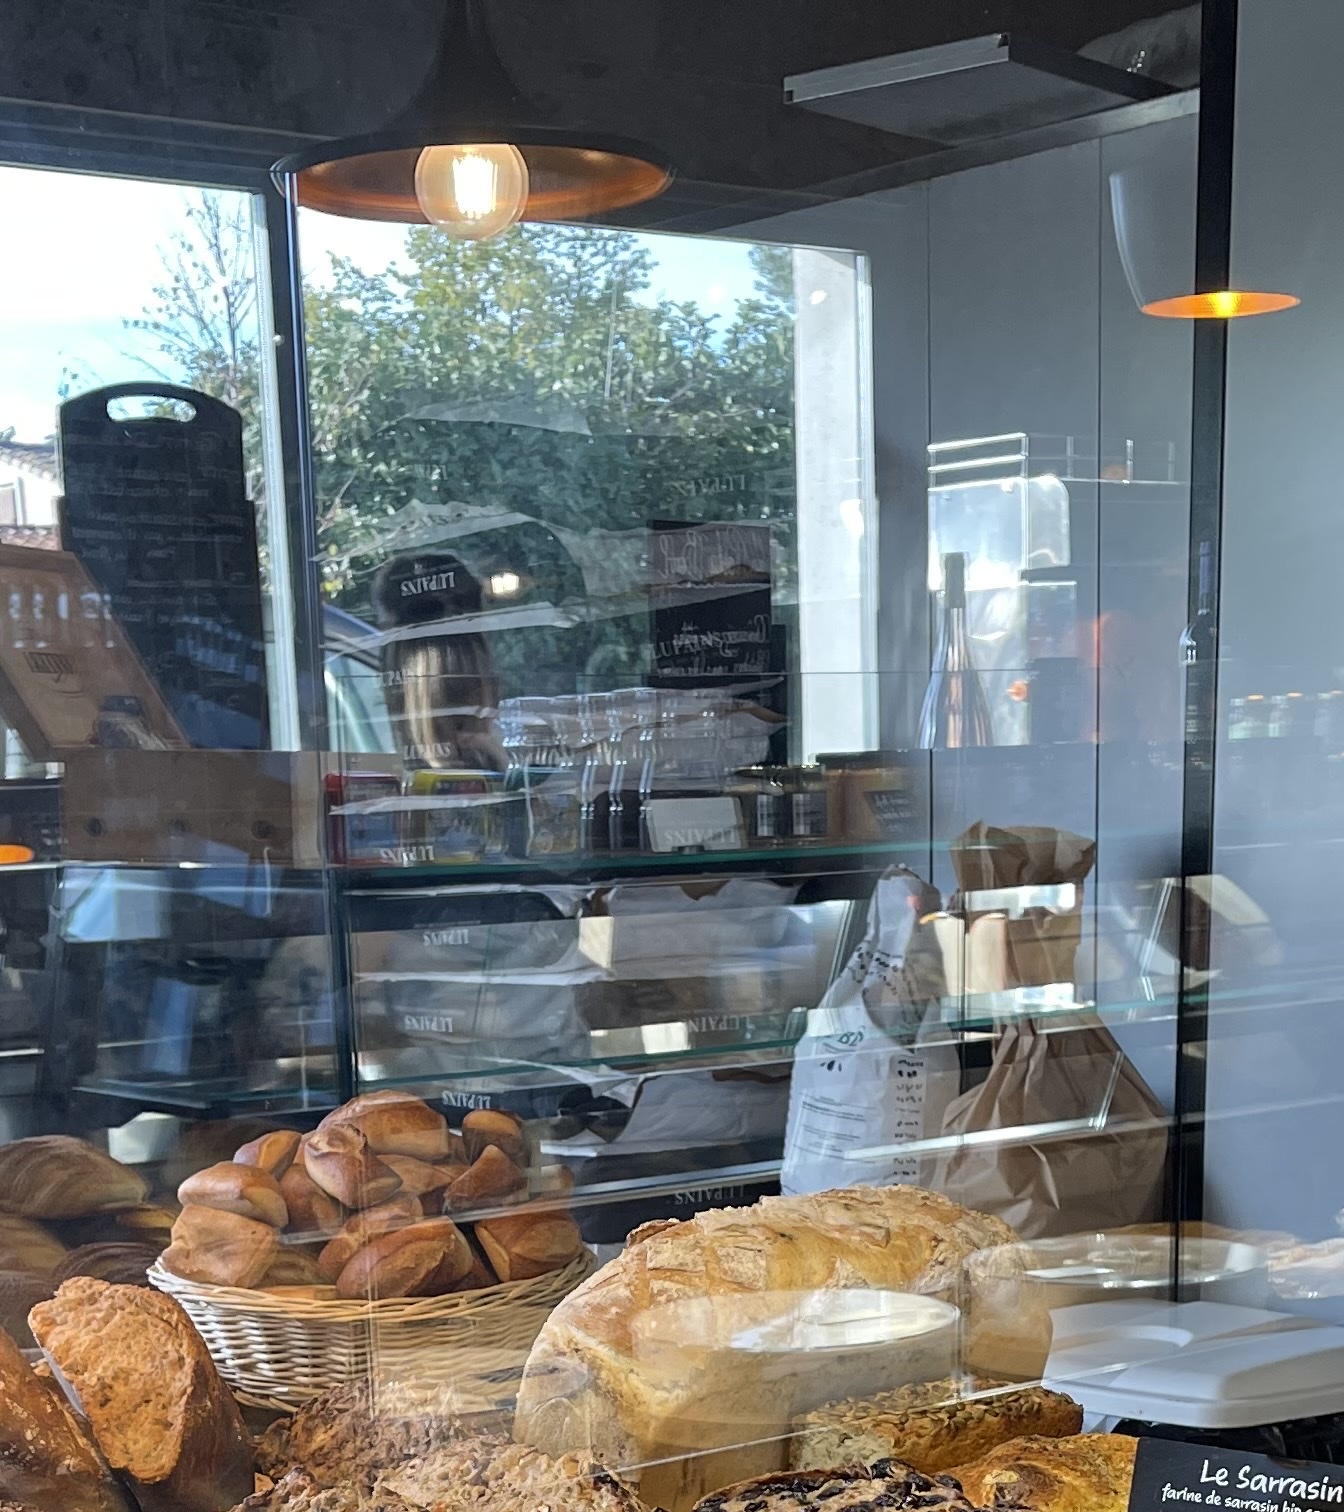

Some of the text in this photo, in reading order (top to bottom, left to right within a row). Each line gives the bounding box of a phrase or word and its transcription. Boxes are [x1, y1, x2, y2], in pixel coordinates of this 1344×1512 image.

[1161, 1482, 1203, 1505] farine
[1205, 1489, 1222, 1506] de
[1199, 1459, 1344, 1504] Le Sarrasin
